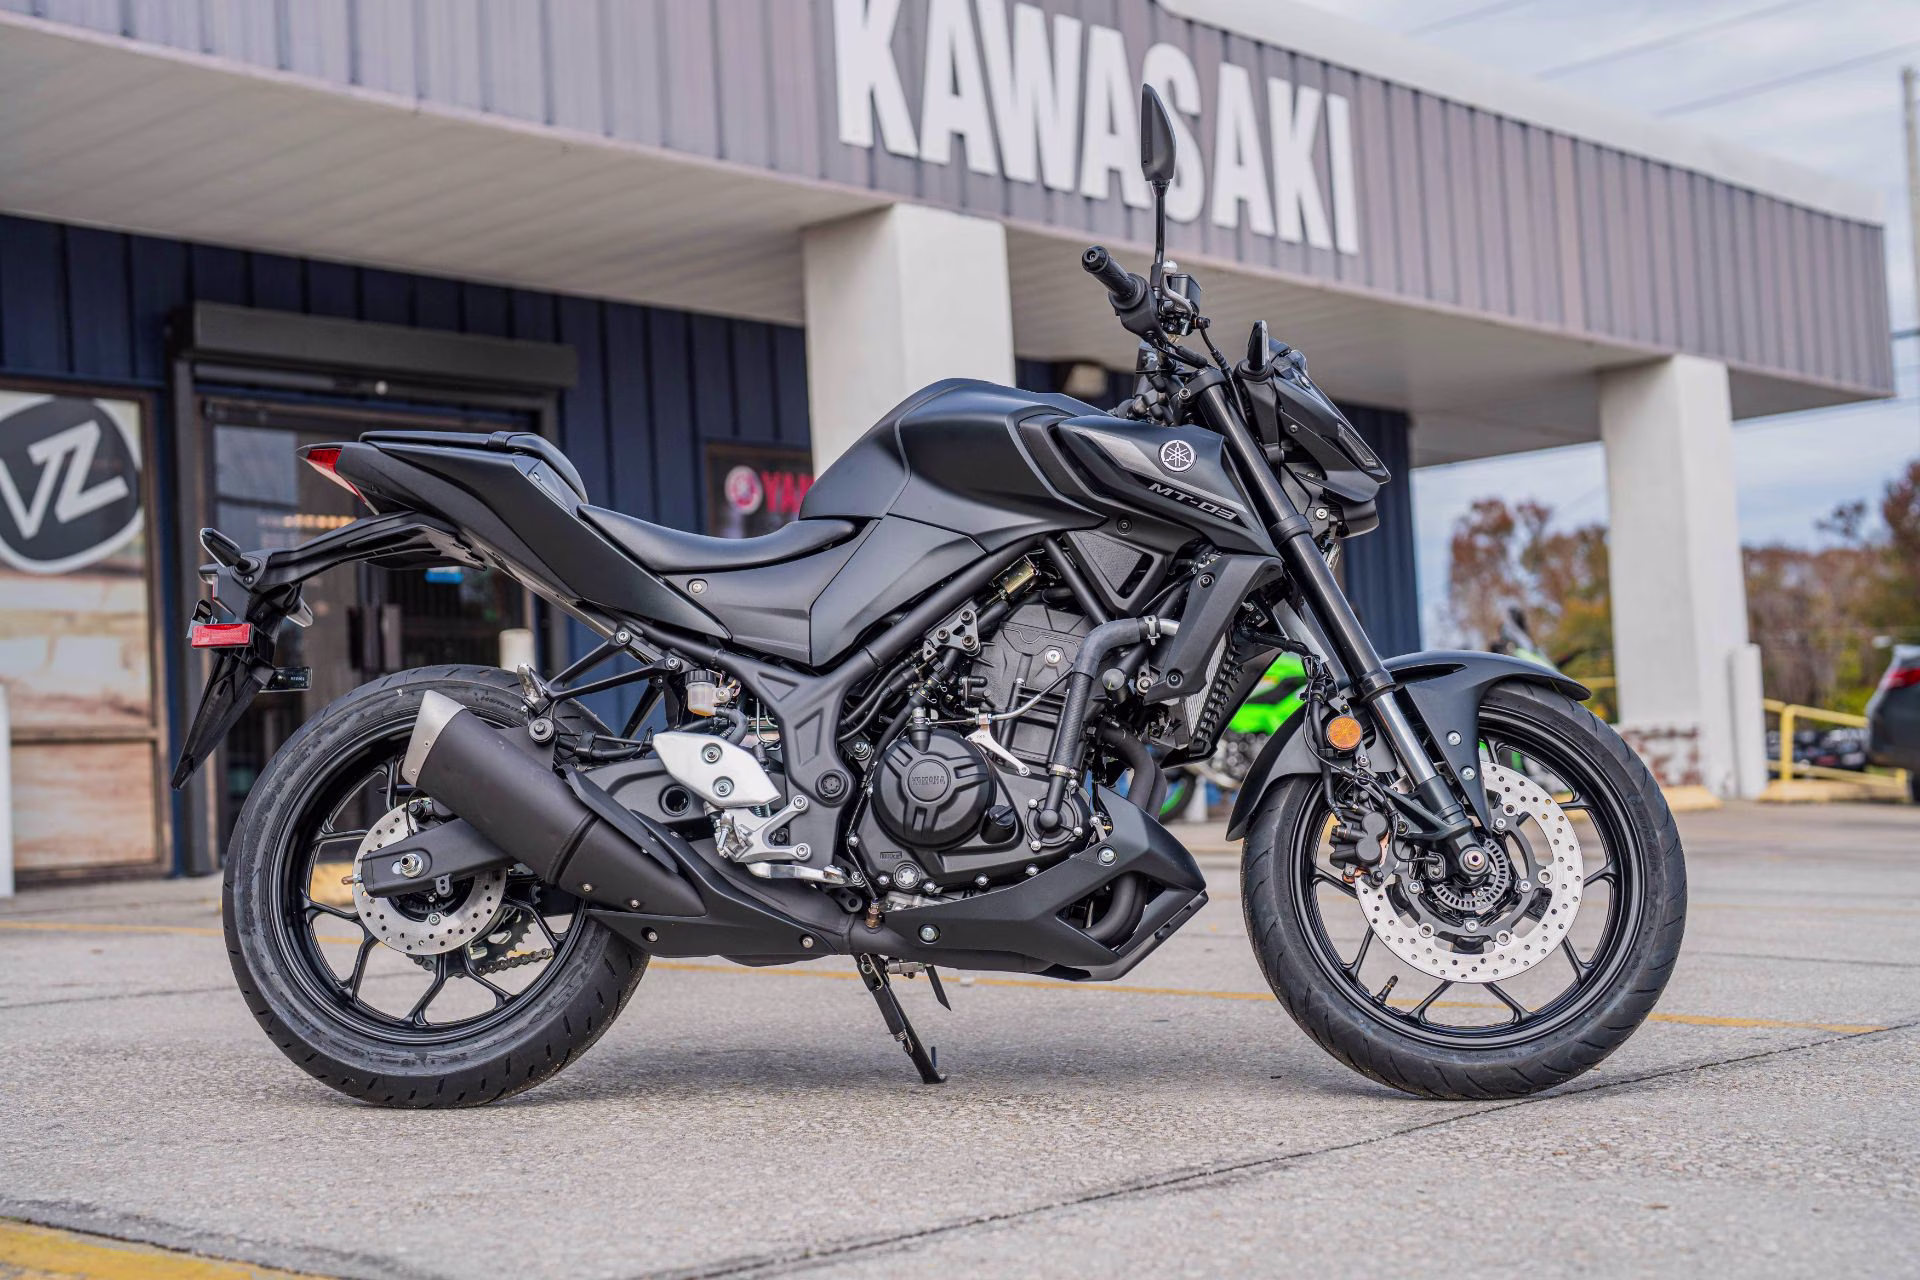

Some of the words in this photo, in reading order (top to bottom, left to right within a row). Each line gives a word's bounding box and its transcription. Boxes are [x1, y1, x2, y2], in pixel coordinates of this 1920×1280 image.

[833, 0, 1359, 255] KAWASAKI
[0, 419, 129, 540] VZ
[1148, 482, 1239, 521] MT-03
